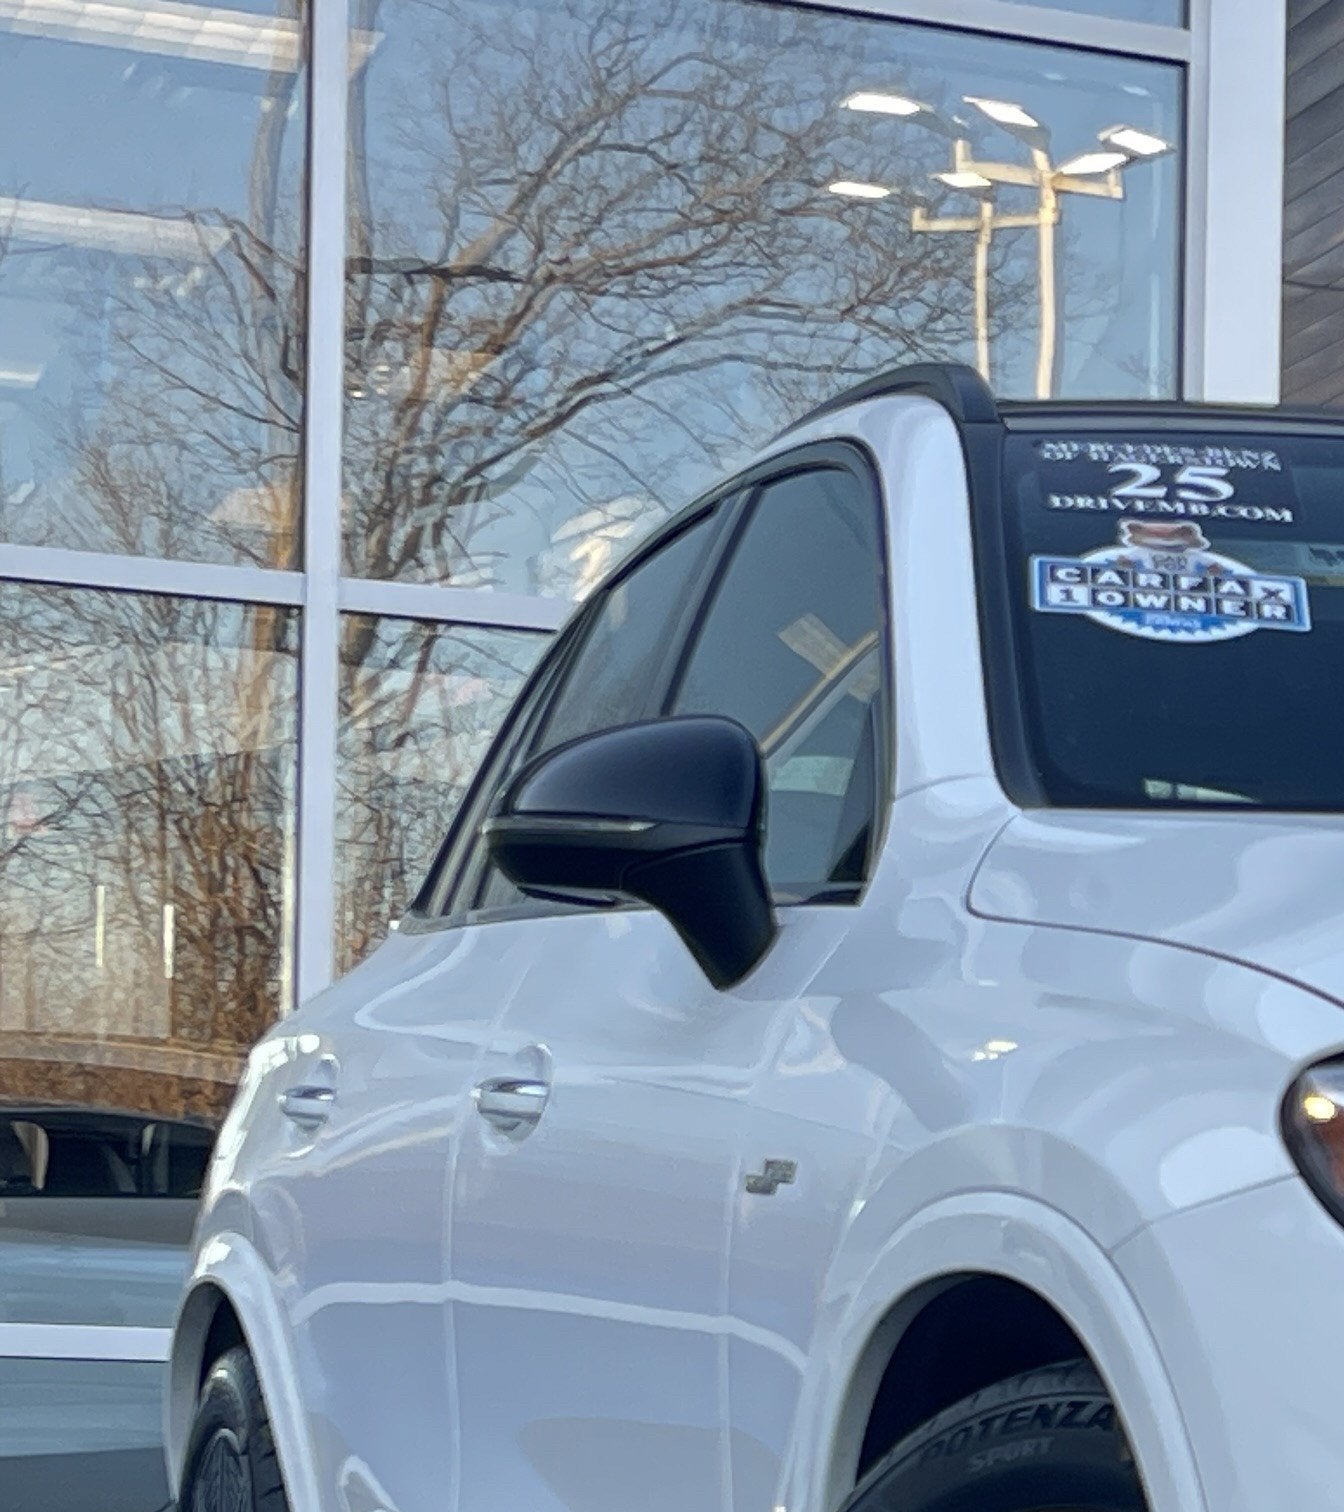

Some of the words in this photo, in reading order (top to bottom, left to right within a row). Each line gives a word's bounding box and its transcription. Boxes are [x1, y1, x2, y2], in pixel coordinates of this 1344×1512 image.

[1107, 462, 1235, 502] 25
[1047, 494, 1294, 523] DRIVEMB.COM
[1055, 567, 1285, 601] CARFAX
[1058, 587, 1079, 603] 1
[1095, 589, 1288, 621] OWNER
[920, 1400, 1115, 1463] POTENZA
